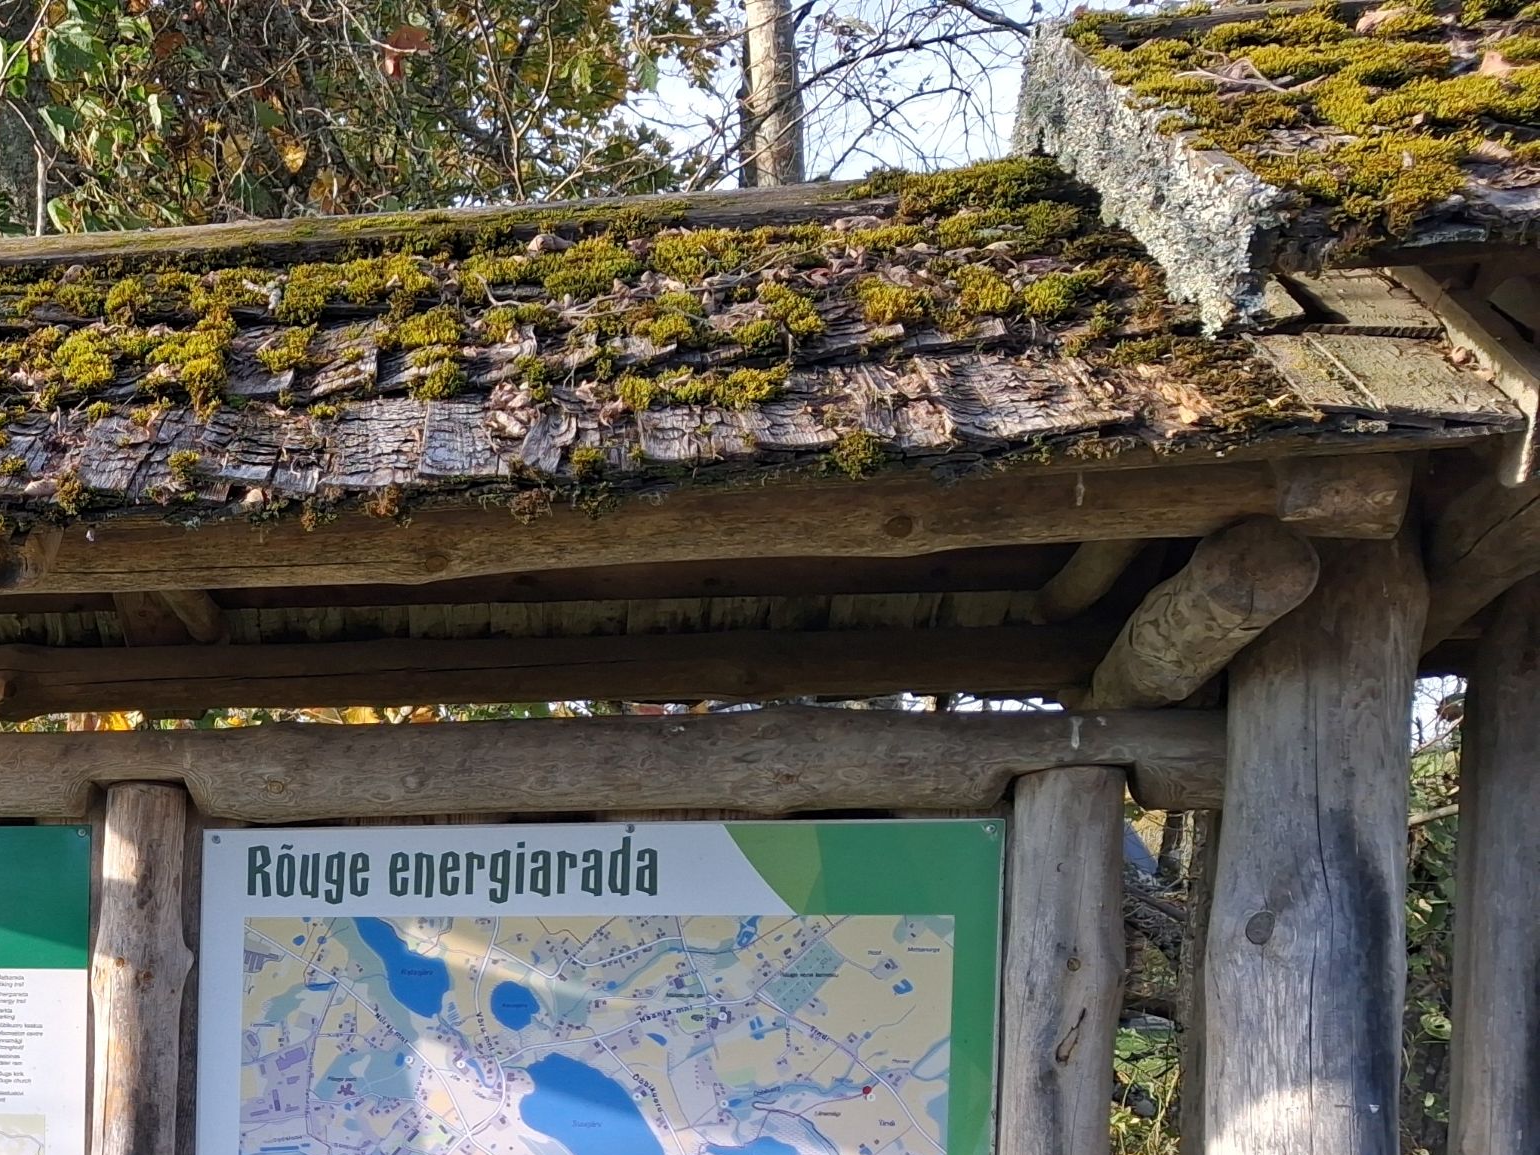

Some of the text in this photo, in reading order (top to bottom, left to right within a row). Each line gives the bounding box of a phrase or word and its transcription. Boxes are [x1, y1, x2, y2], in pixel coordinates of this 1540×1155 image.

[247, 836, 658, 904] Rõuge energiarada
[632, 1073, 664, 1113] Ööbikuoru
